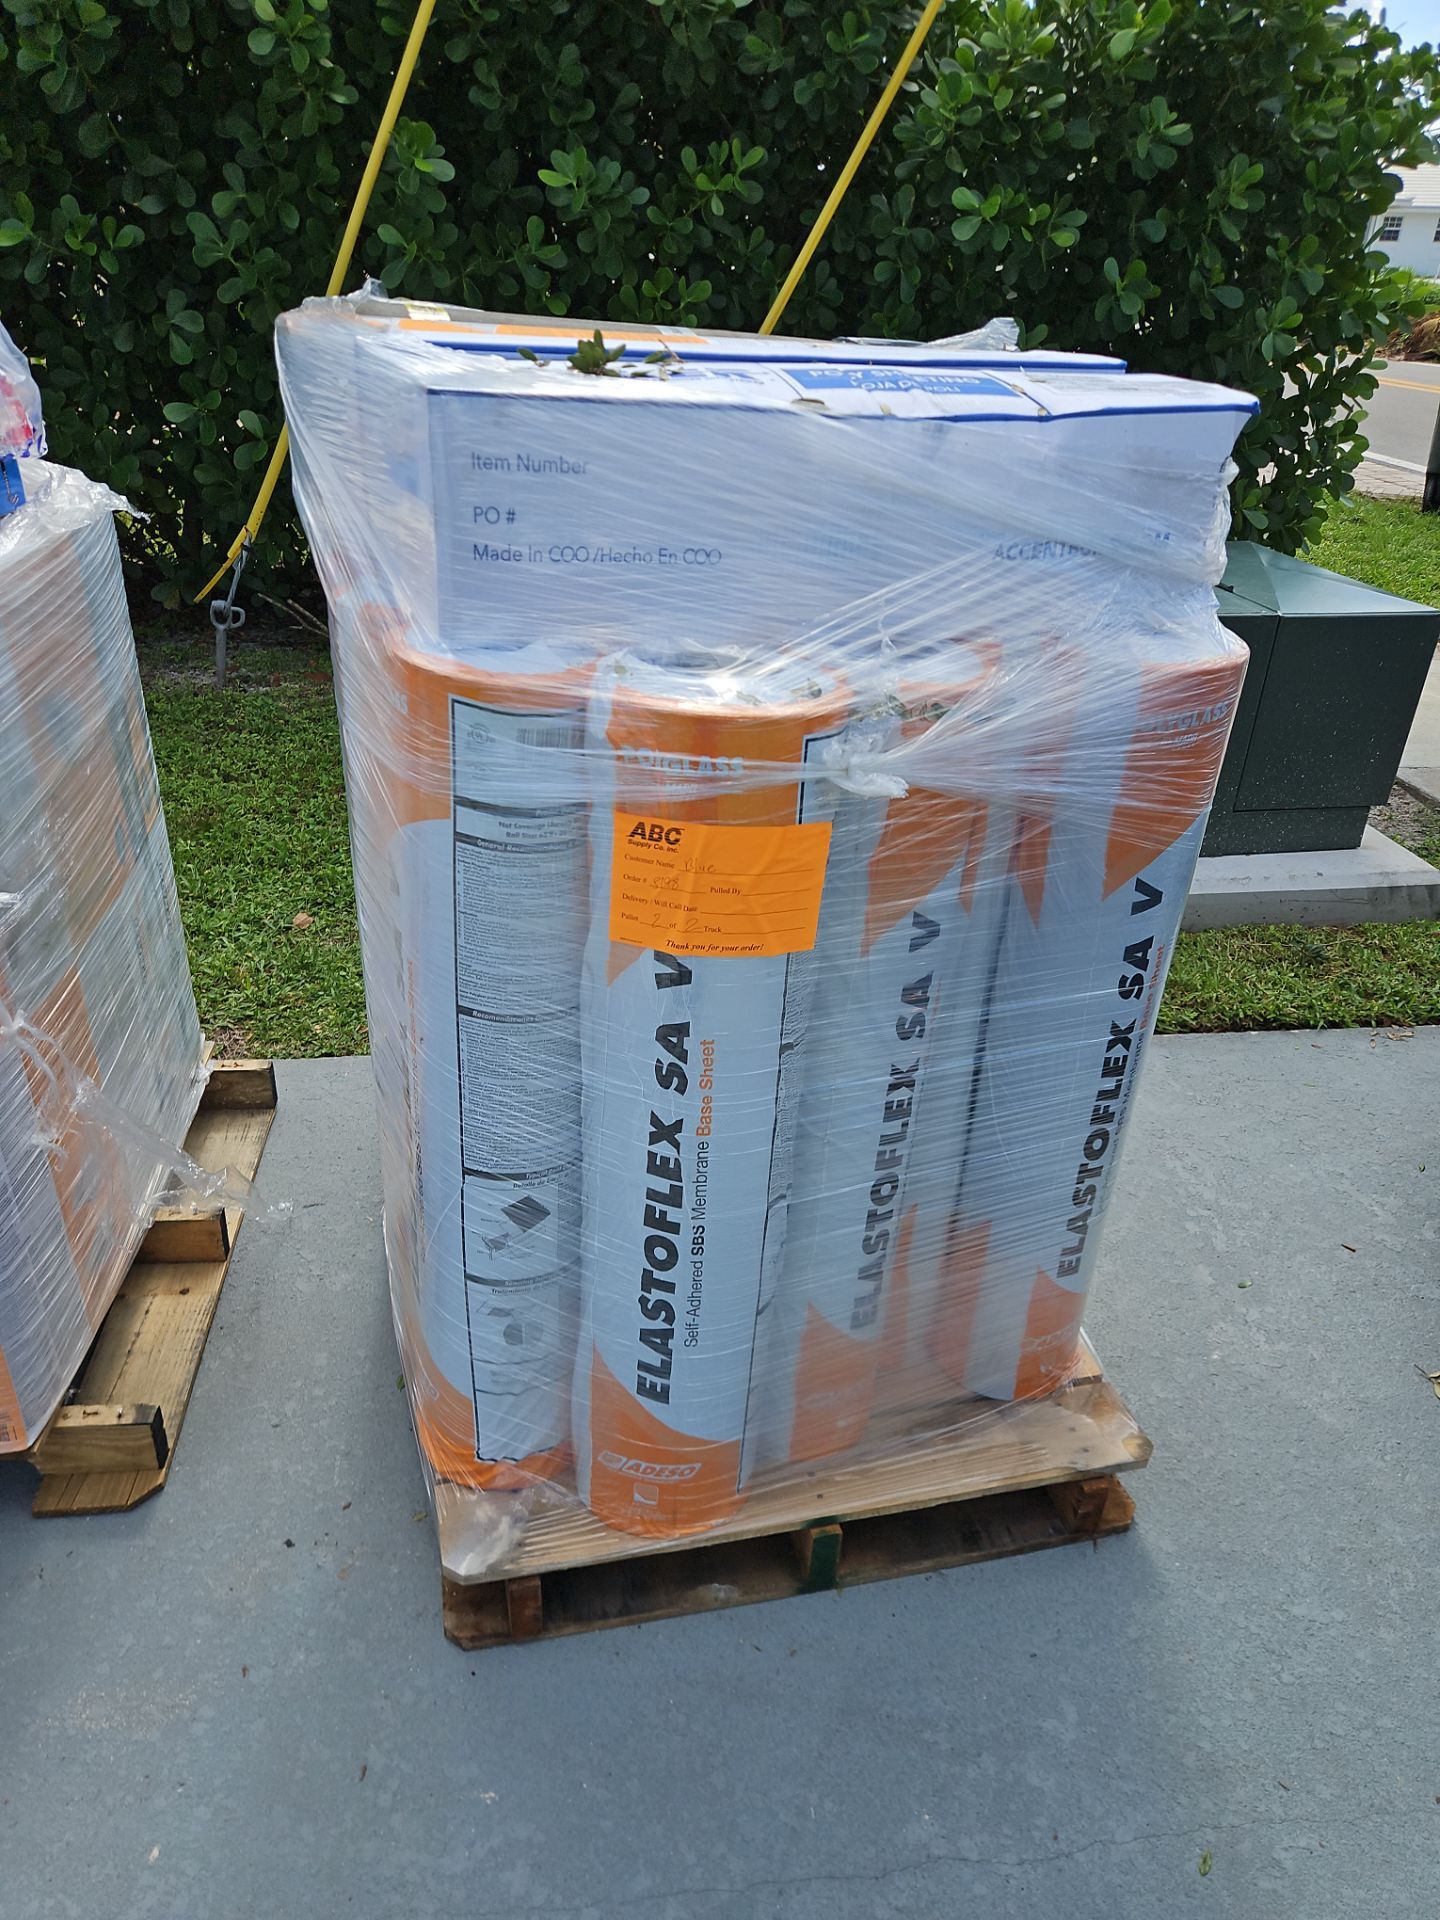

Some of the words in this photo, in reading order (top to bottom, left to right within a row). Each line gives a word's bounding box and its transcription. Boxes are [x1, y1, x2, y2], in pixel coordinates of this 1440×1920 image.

[470, 452, 511, 472] Item
[516, 453, 589, 475] Number
[473, 506, 500, 525] PO
[506, 508, 516, 525] #
[473, 543, 522, 563] Made
[528, 545, 543, 563] In
[658, 547, 678, 565] En
[683, 548, 722, 566] COO
[626, 821, 685, 846] ABC
[627, 838, 652, 850] Supply
[655, 859, 675, 869] Name
[622, 892, 648, 905] Delivery
[668, 901, 682, 910] Call
[710, 886, 731, 895] Pulled
[1130, 877, 1164, 917] V
[666, 939, 690, 951] Thank
[691, 944, 706, 953] you
[706, 943, 720, 953] for
[719, 944, 738, 953] your
[740, 943, 765, 952] order!
[703, 925, 722, 934] Truck
[908, 910, 942, 954] V
[653, 951, 693, 991] V
[1118, 935, 1155, 1001] SA
[895, 971, 934, 1041] SA
[654, 1021, 691, 1097] SA
[700, 1038, 716, 1091] Sheet
[696, 1095, 713, 1138] Base
[1056, 1018, 1137, 1279] ELASTOFLEX
[691, 1140, 711, 1221] Membrane
[850, 1057, 920, 1331] ELASTOFLEX
[636, 1110, 685, 1405] ELASTOFLEX
[691, 1225, 706, 1257] SBS
[684, 1259, 704, 1348] Self-Adhered
